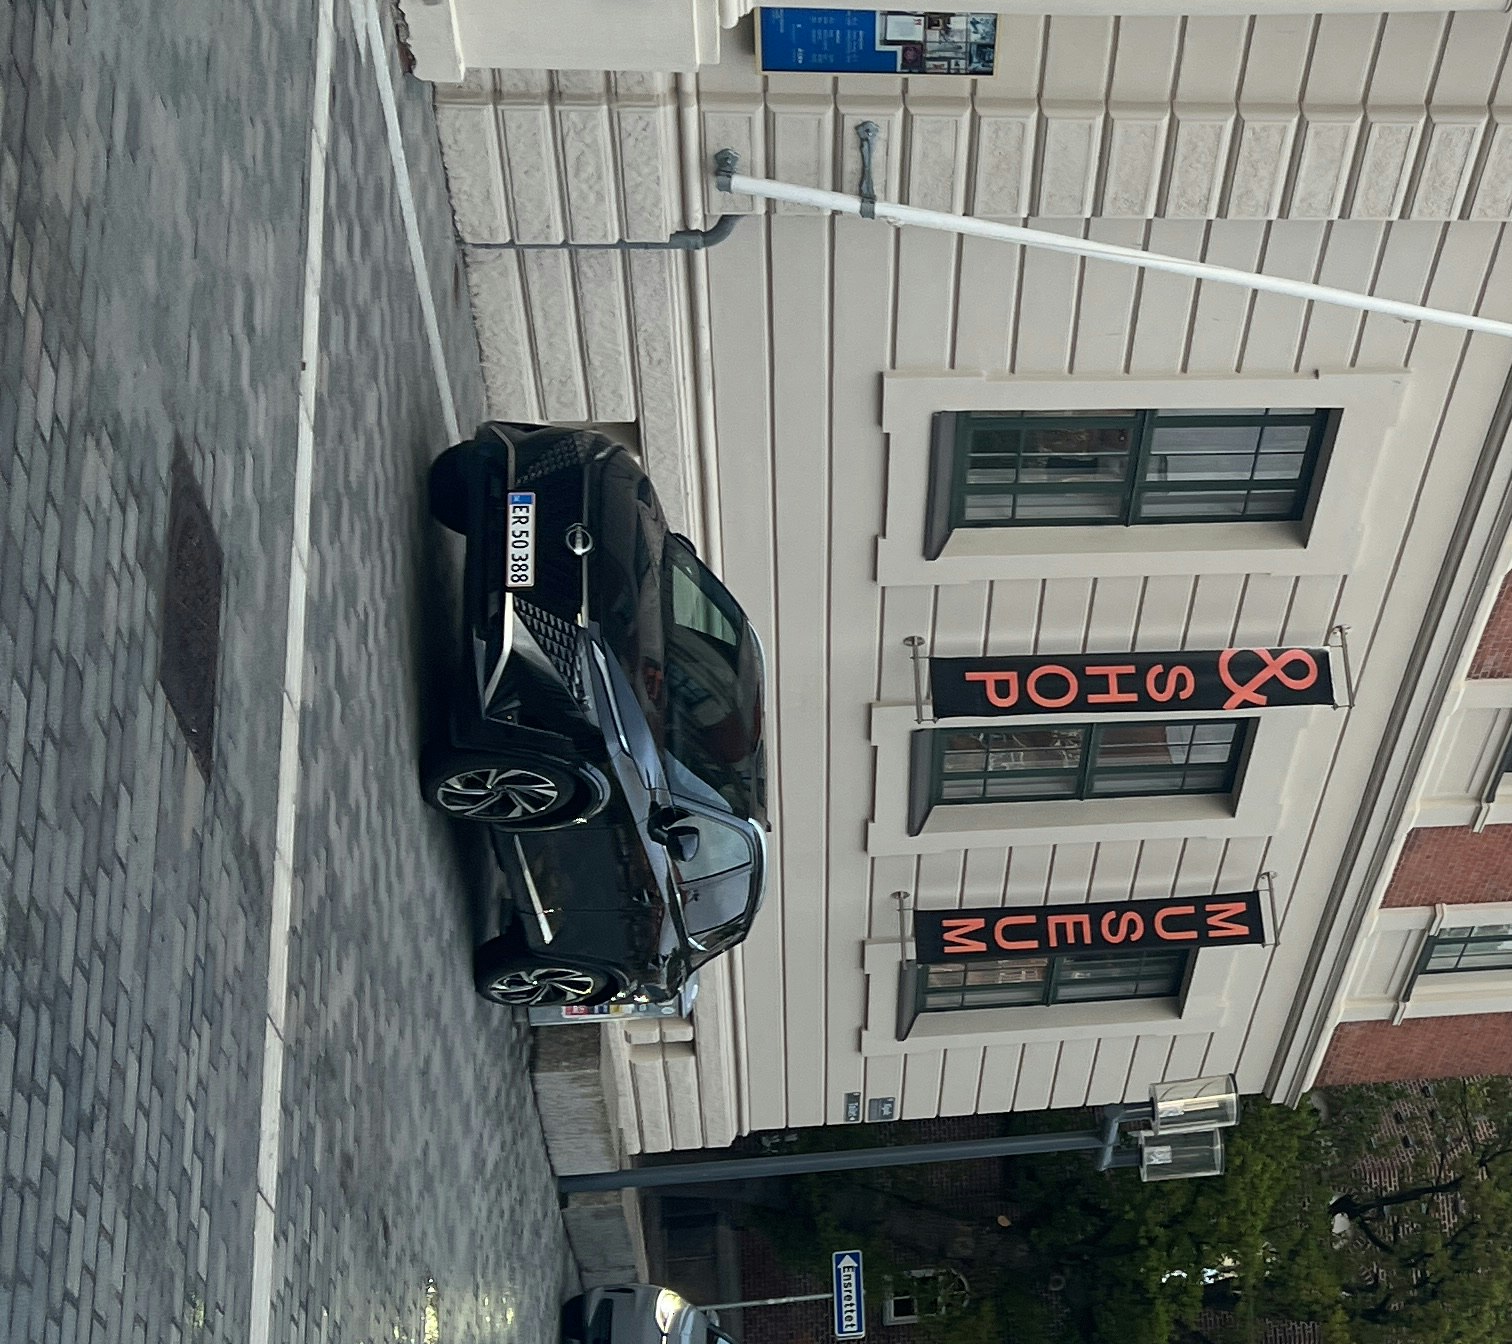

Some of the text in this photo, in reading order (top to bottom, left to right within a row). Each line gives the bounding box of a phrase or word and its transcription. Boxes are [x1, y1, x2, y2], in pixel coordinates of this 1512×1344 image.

[511, 505, 529, 583] ER 50 388
[964, 647, 1318, 710] & SHOP
[940, 901, 1250, 954] MUSEUM
[843, 1265, 856, 1329] Ensrettet
